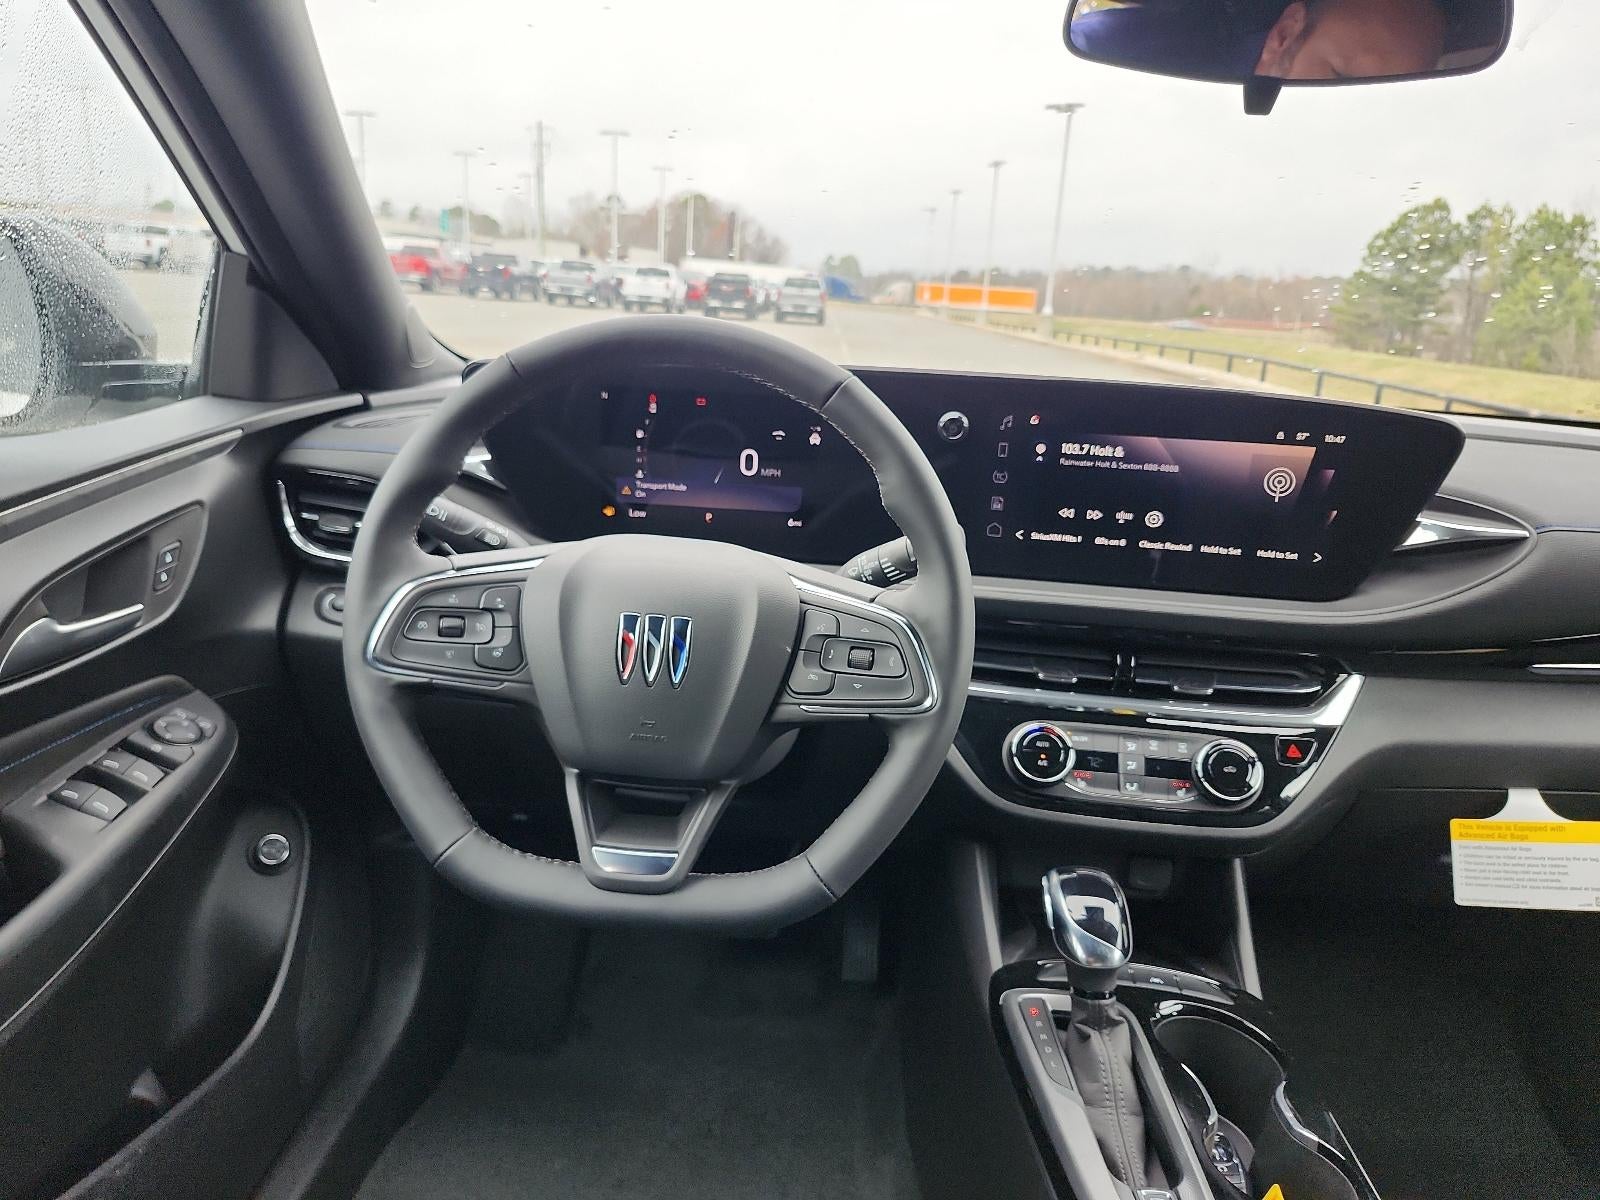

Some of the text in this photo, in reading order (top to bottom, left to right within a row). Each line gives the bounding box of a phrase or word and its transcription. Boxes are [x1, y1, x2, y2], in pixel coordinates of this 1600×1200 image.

[1325, 434, 1346, 444] 10:47
[1061, 442, 1125, 458] 103.7 Holt &
[740, 448, 781, 477] 0 MPH
[1060, 458, 1095, 467] Rainwater
[1095, 461, 1110, 469] Holt
[1118, 462, 1142, 471] Sexton
[635, 480, 687, 492] Transport Mode
[634, 489, 646, 498] On
[628, 508, 647, 517] Low
[1030, 531, 1062, 542] SiriusXM
[1062, 534, 1077, 543] Hits
[1139, 539, 1193, 551] Classic Rewind
[1200, 545, 1242, 555] Hold to Set
[1256, 549, 1275, 558] Hold
[1284, 551, 1298, 559] Set
[1458, 831, 1494, 839] Advanced
